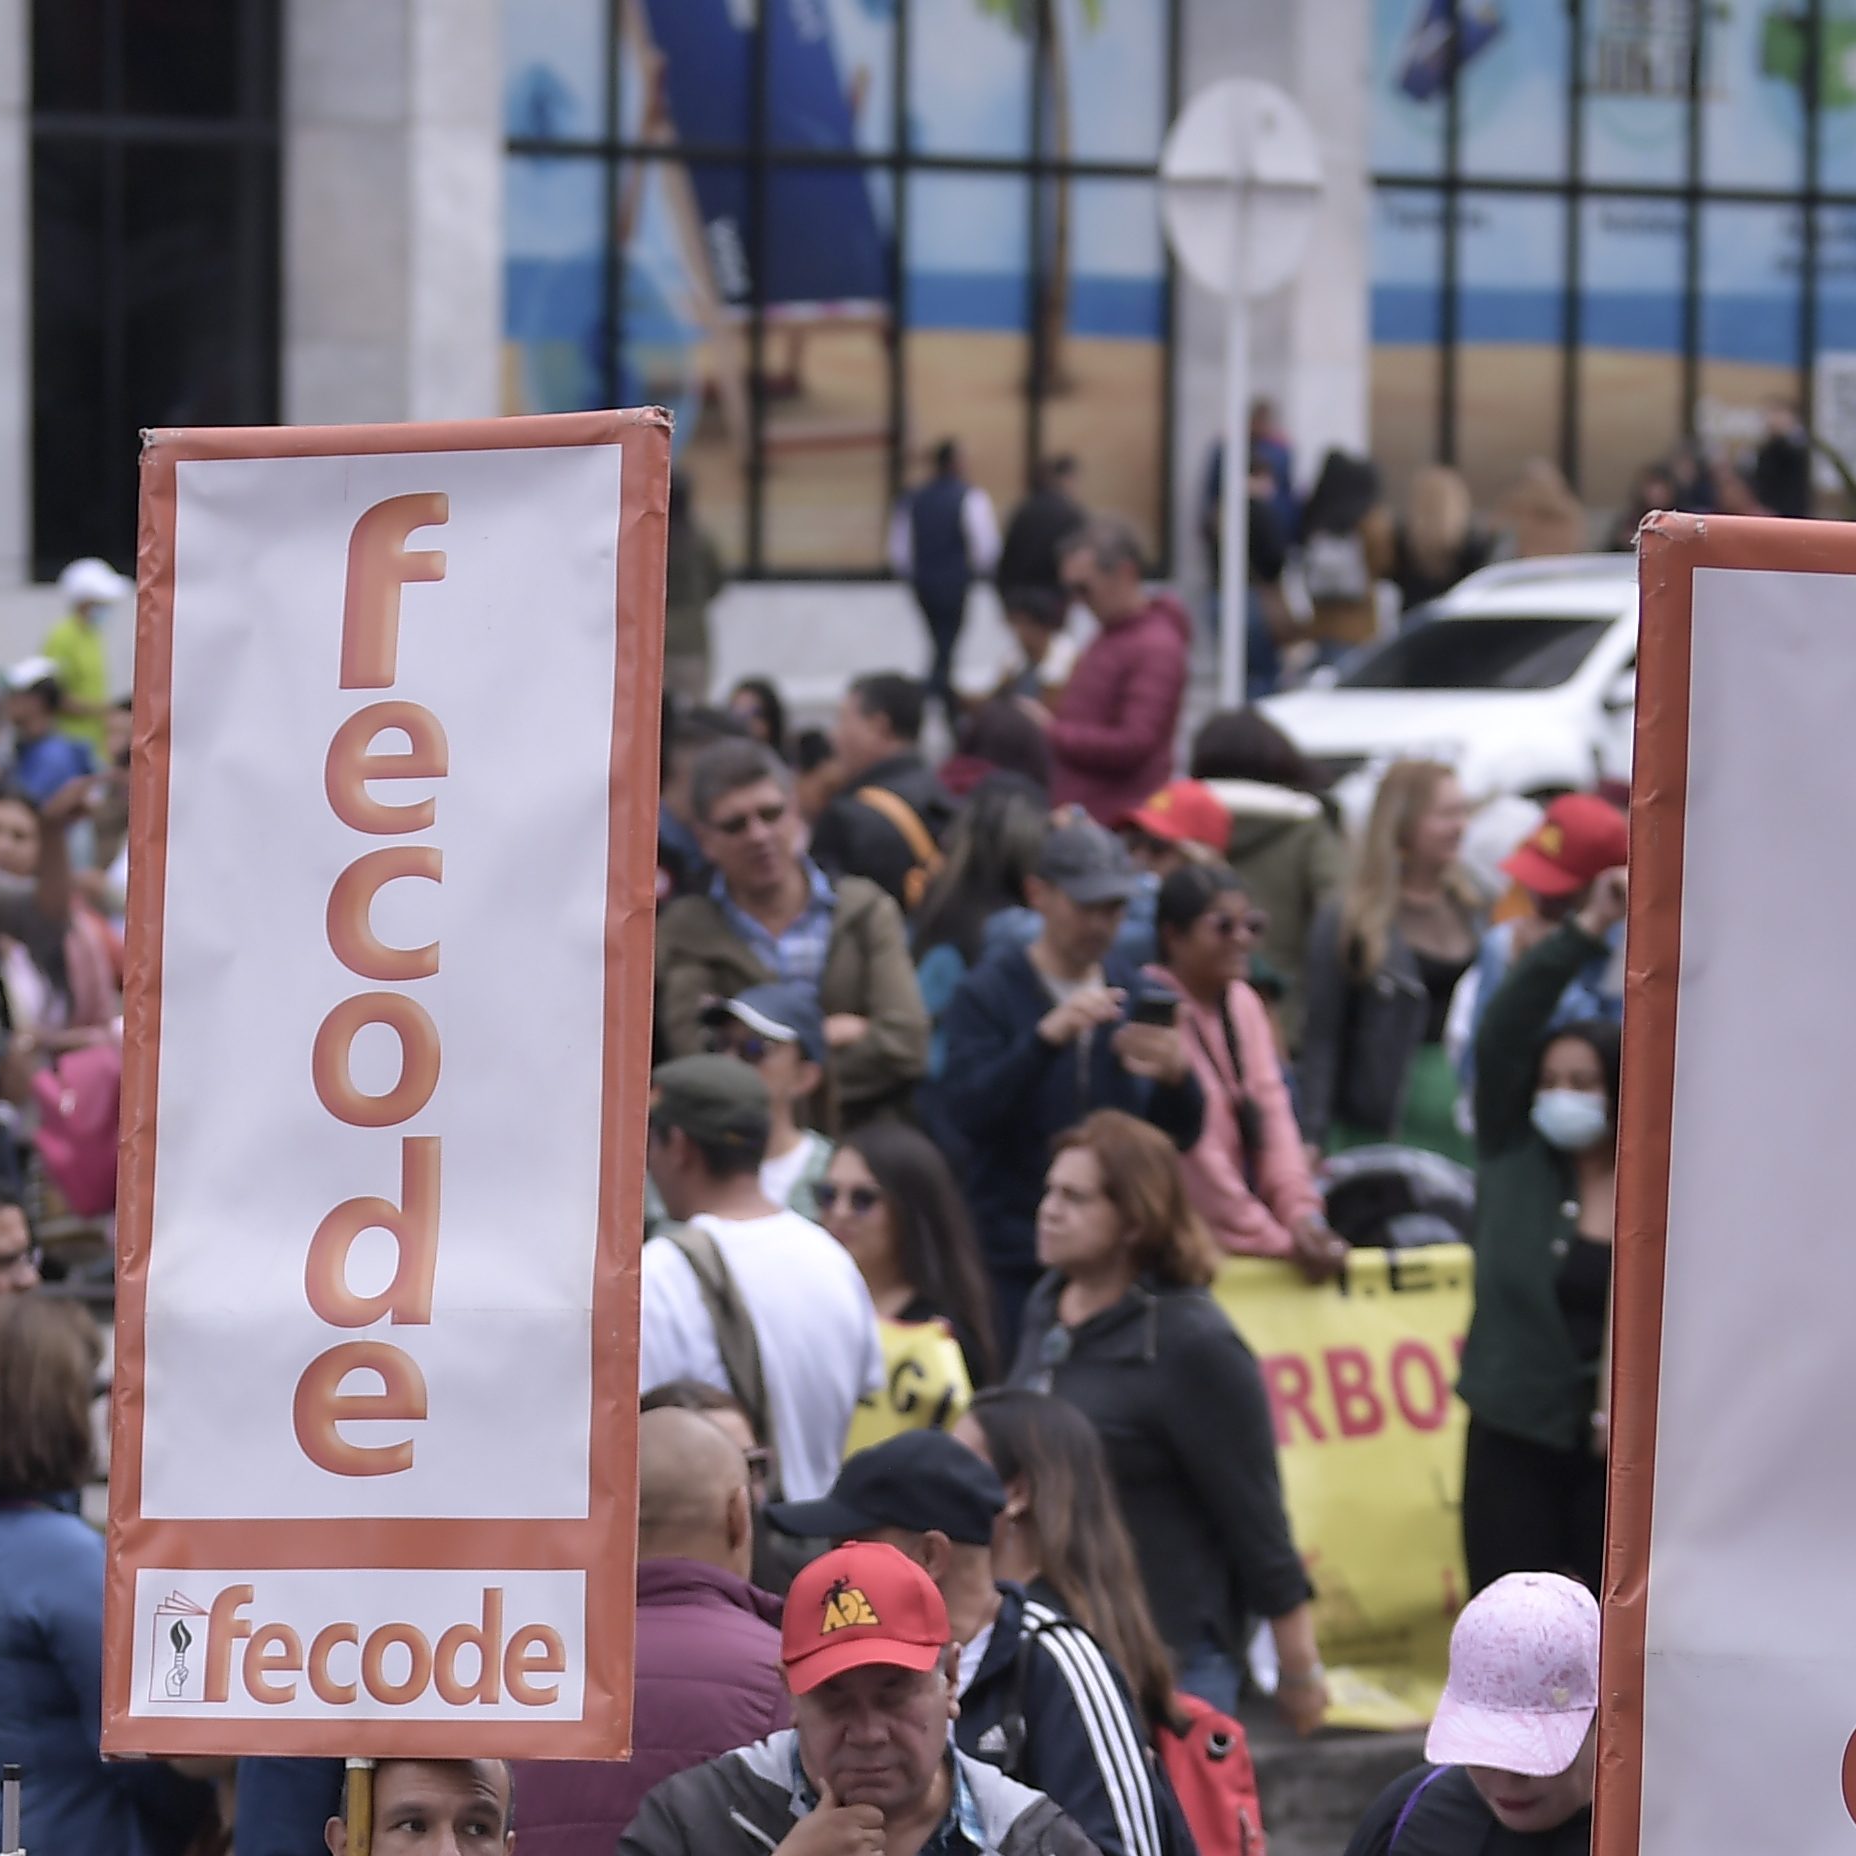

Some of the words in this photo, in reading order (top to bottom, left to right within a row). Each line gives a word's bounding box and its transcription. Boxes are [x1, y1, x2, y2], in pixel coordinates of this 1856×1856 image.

[293, 491, 451, 1477] fecode
[1260, 1335, 1467, 1446] RBO
[206, 1584, 566, 1707] fecode
